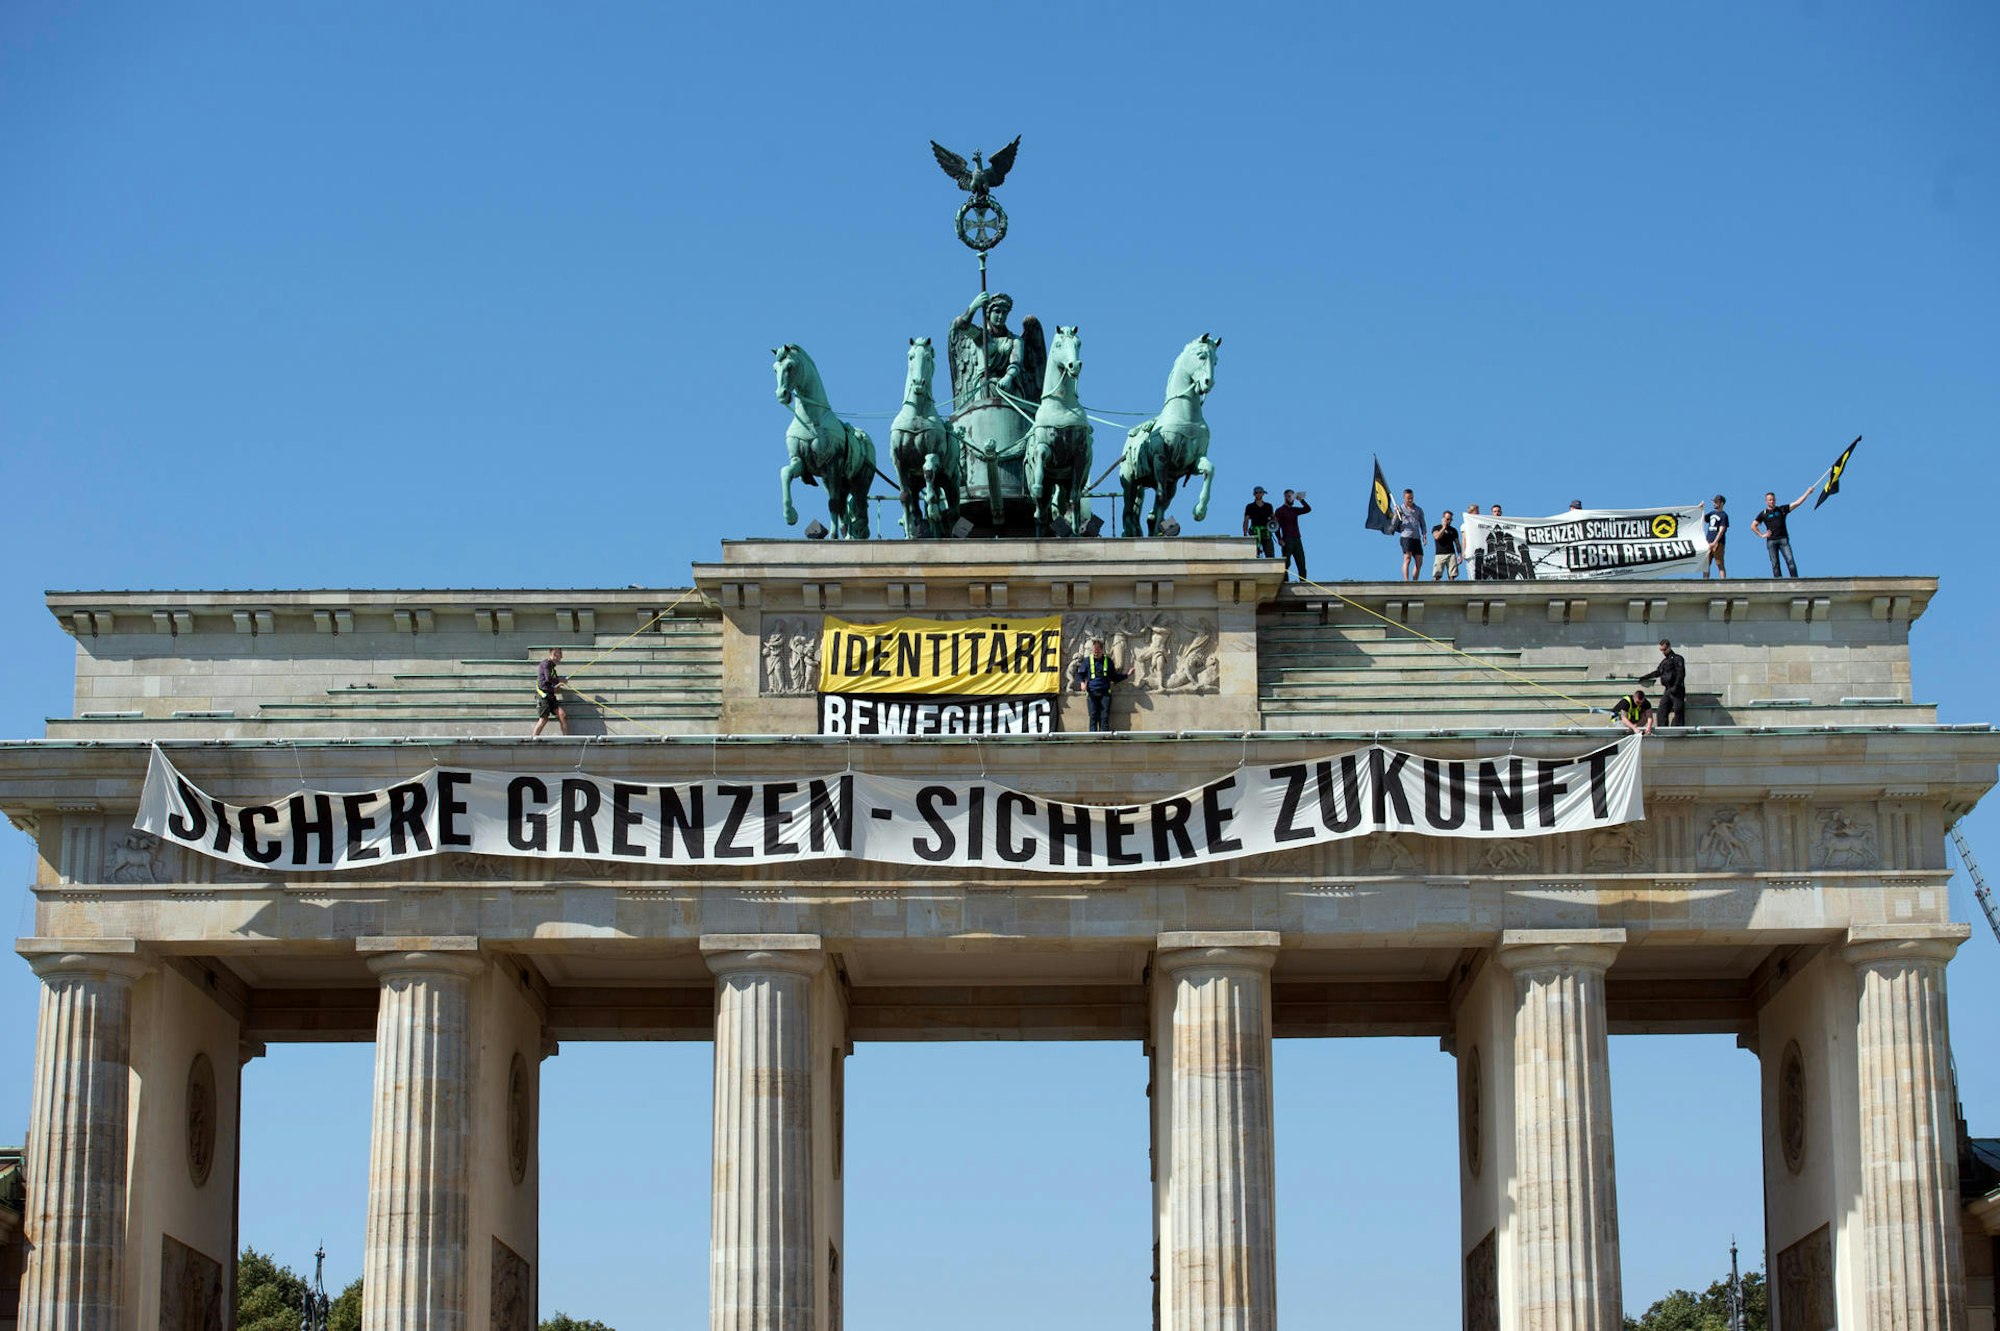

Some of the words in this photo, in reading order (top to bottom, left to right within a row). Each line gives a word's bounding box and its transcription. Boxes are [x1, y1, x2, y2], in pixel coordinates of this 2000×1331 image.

[1527, 522, 1584, 544] GRENZEN
[1586, 517, 1650, 540] SCHÜTZEN!
[1569, 544, 1620, 568] LEBEN
[1624, 541, 1692, 563] RETTEN!
[830, 623, 1060, 678] IDENTITÄRE
[823, 695, 1051, 734] BEWEGUNG
[168, 772, 472, 865] SICHERE
[507, 775, 854, 860] GRENZEN
[912, 775, 1244, 867] SICHERE
[1269, 744, 1619, 843] ZUKUNFT
